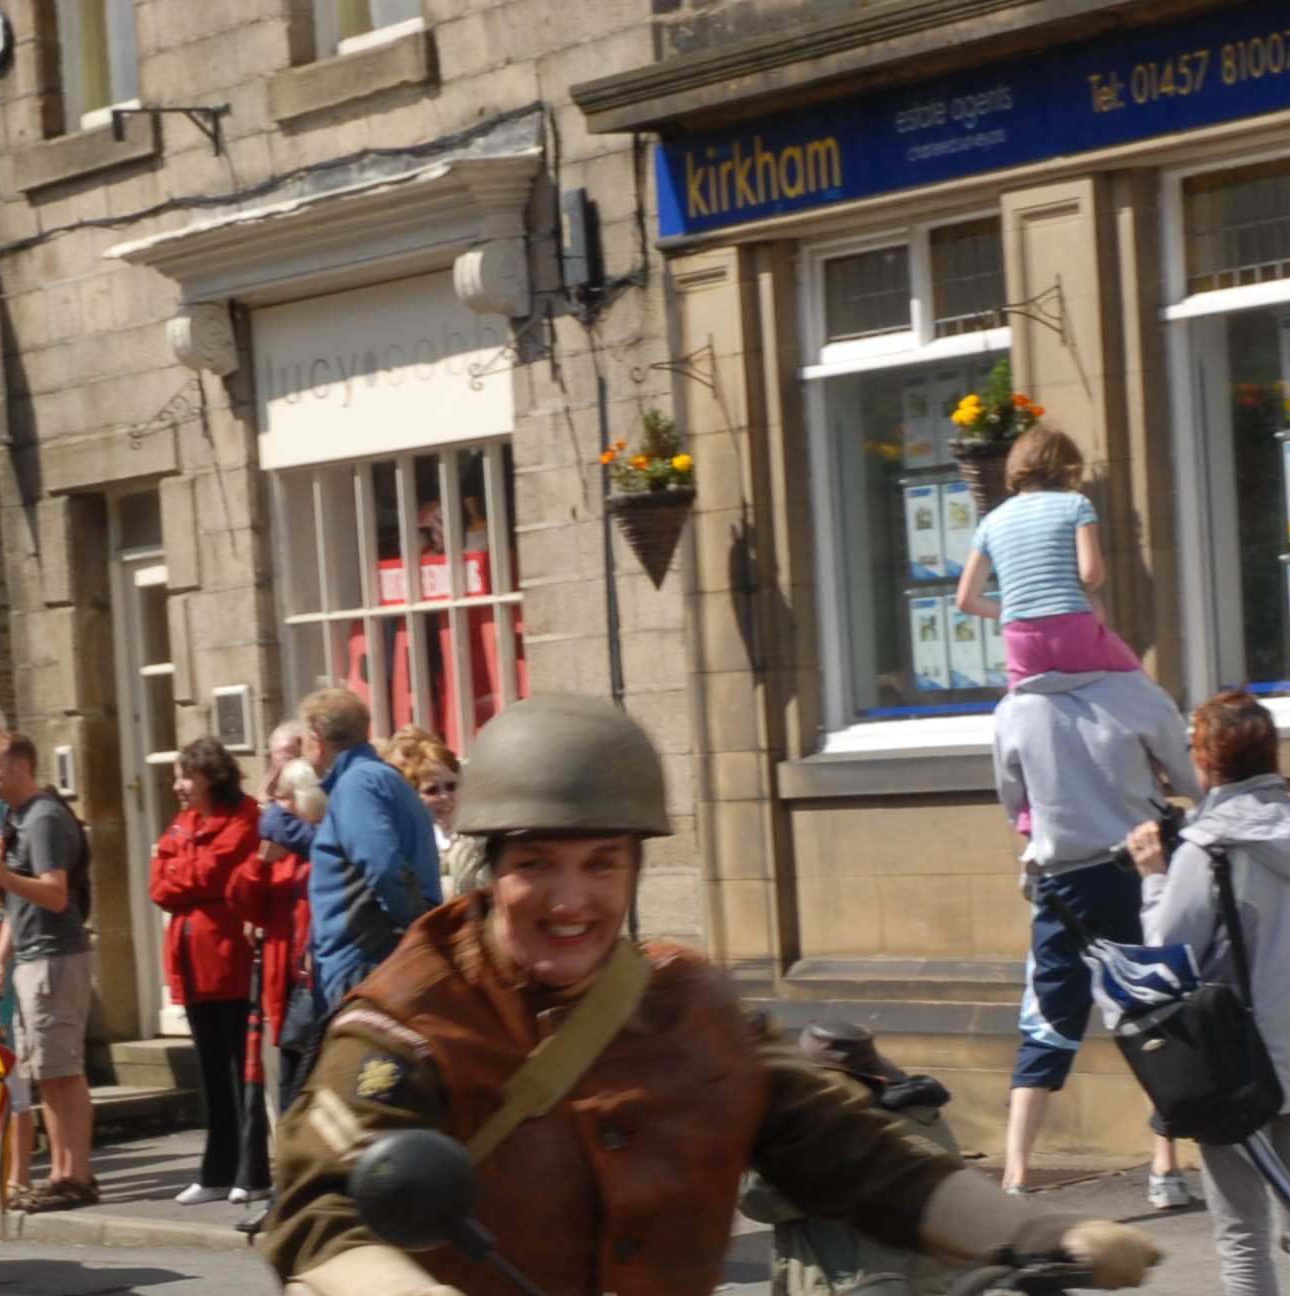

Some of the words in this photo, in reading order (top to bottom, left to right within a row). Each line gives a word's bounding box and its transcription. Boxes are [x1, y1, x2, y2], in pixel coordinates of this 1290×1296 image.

[895, 98, 947, 133] estate
[950, 81, 1013, 129] agents
[1088, 72, 1125, 113] Tel:
[1131, 49, 1210, 104] 01457
[686, 135, 842, 218] kirkham
[264, 350, 358, 408] lucy
